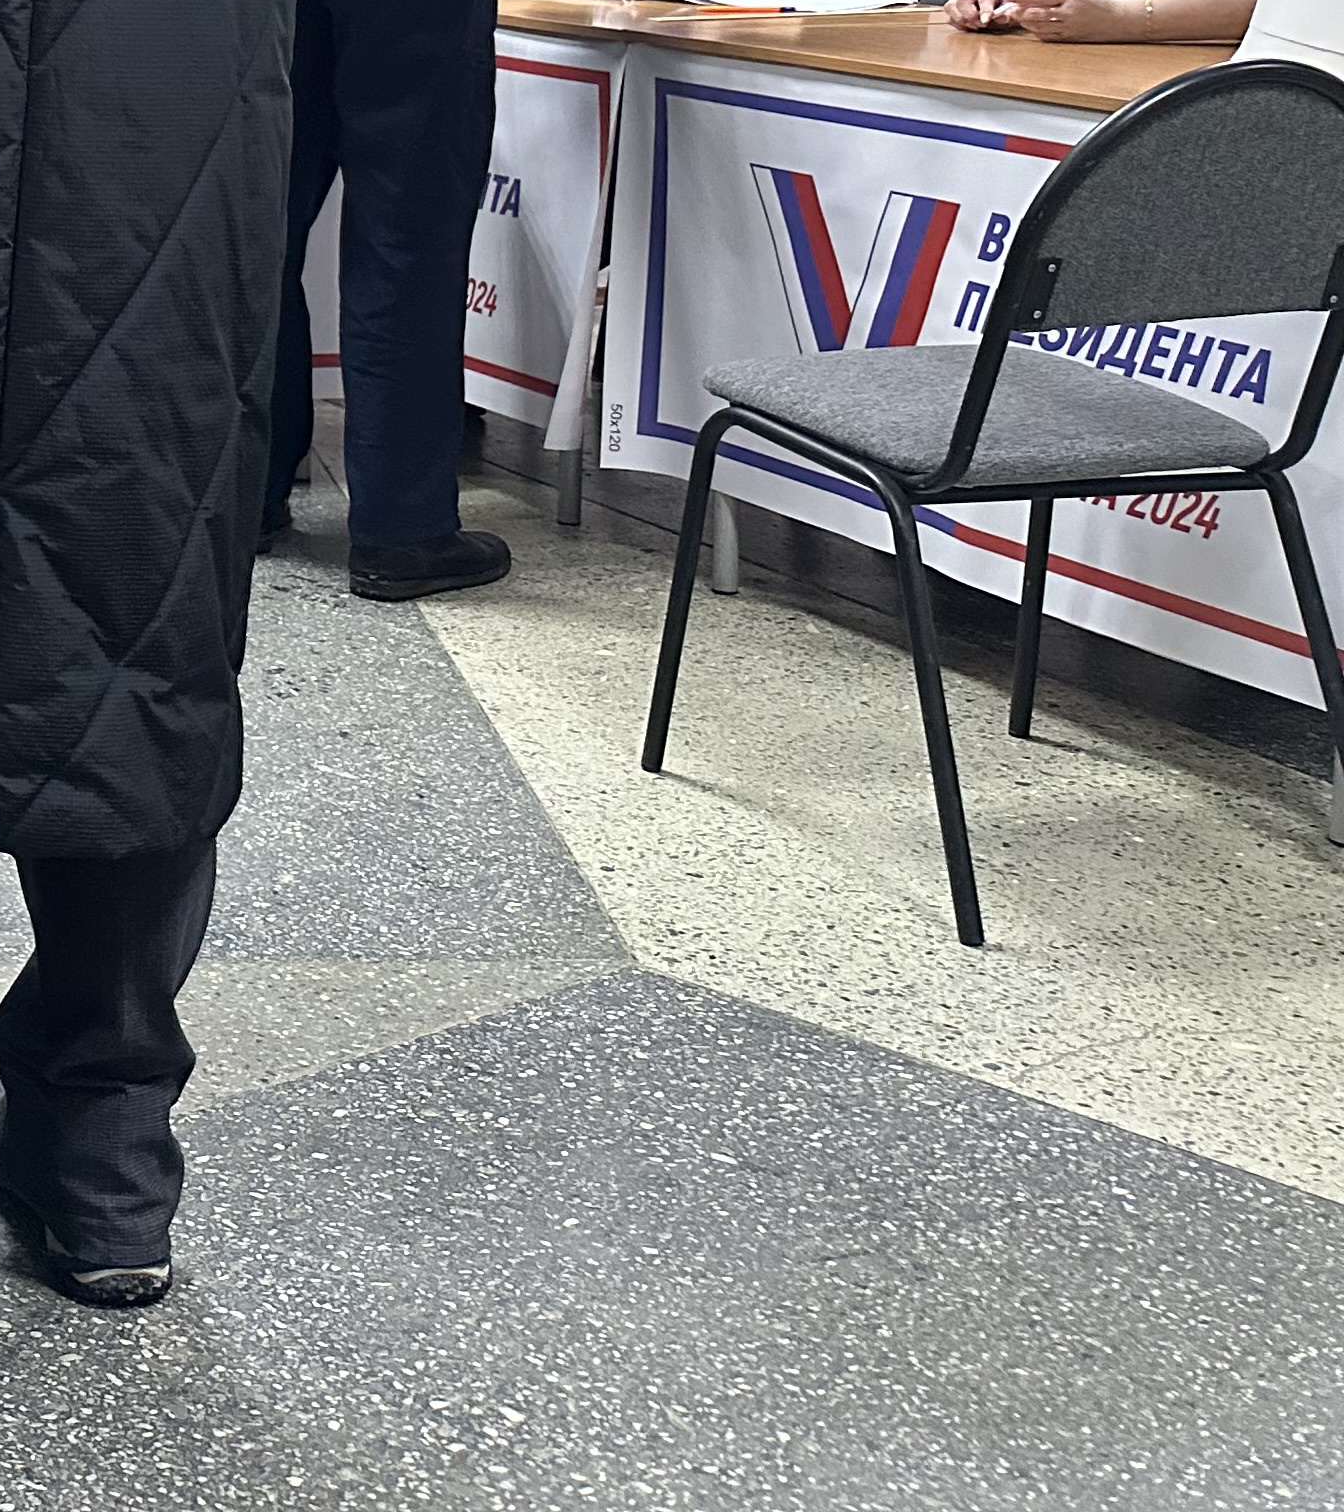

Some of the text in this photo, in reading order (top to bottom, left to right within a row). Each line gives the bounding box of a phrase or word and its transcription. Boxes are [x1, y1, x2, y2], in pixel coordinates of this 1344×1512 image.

[953, 280, 1273, 405] ПЗИДЕНТА
[608, 403, 624, 452] 50x120
[1125, 490, 1221, 540] 2024
